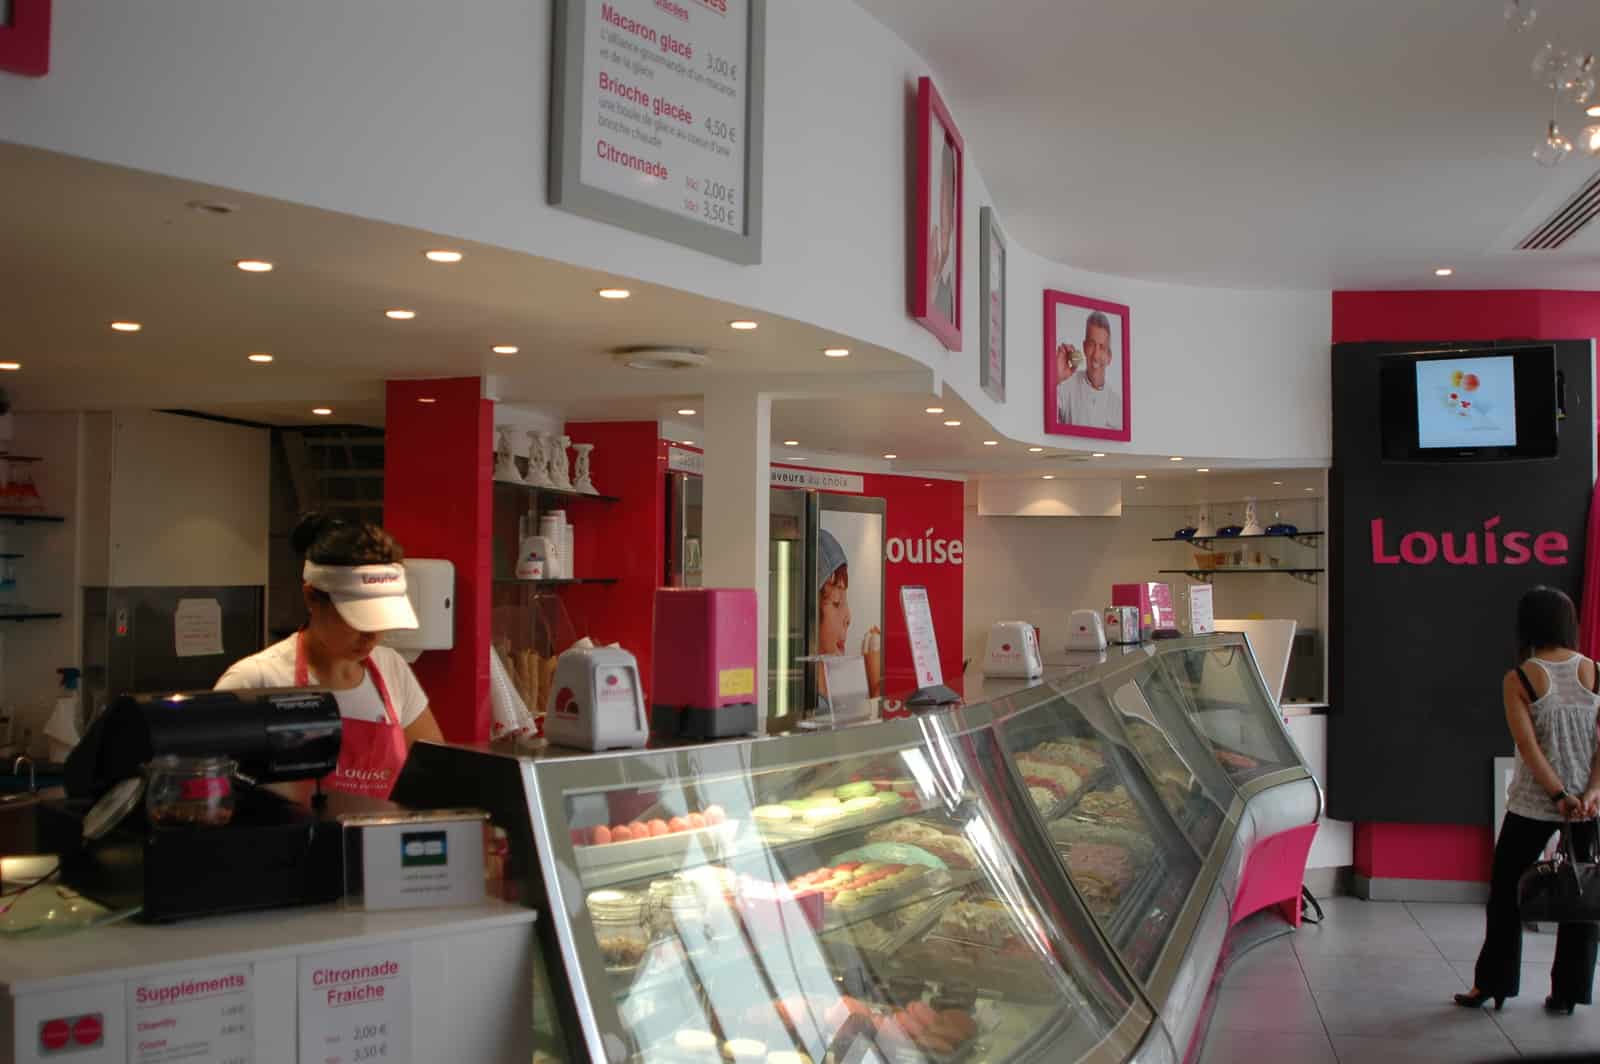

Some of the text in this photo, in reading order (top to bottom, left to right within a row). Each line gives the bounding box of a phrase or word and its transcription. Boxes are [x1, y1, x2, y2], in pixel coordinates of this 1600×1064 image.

[600, 3, 693, 60] Macaron glacé
[599, 72, 693, 125] Brioche glacée
[705, 116, 736, 143] 4,50 €
[597, 139, 668, 179] Citronnade
[704, 179, 726, 201] 2,00
[727, 188, 736, 205] €
[704, 201, 726, 223] 3,50
[727, 209, 736, 227] €
[884, 527, 963, 565] ouíse
[312, 960, 399, 986] Citronnade
